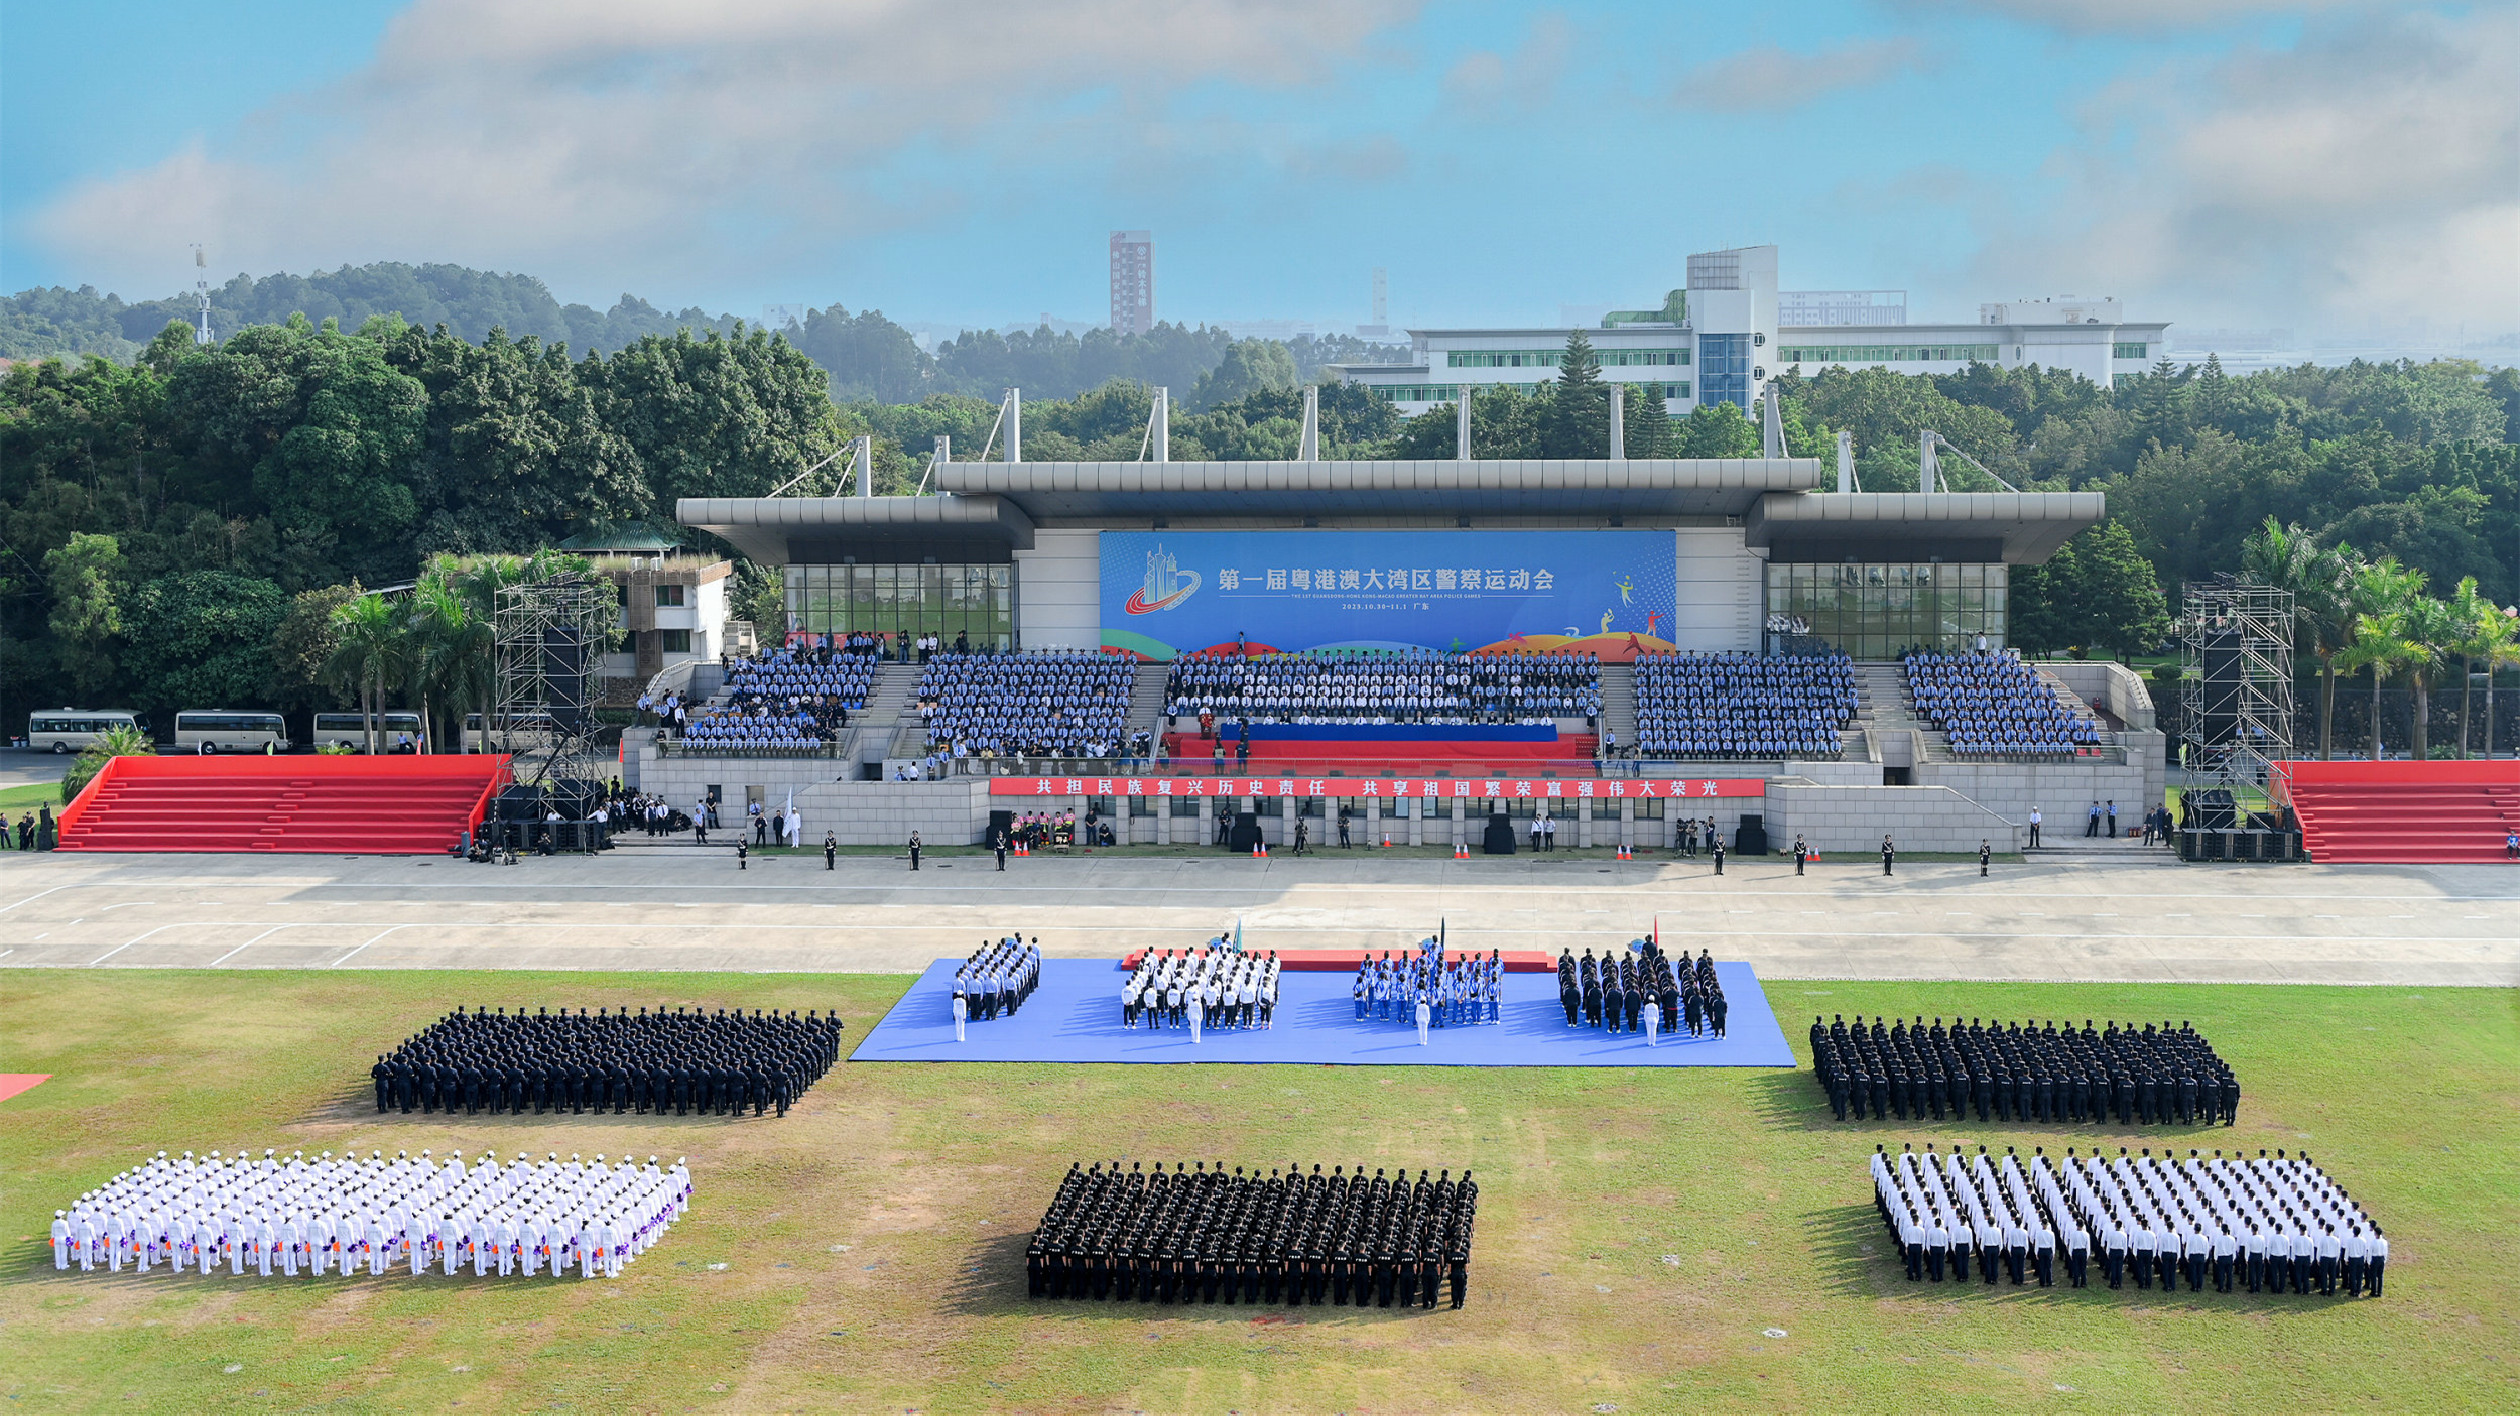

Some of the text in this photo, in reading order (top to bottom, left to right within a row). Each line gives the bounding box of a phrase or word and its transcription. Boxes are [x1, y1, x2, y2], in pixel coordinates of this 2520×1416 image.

[1218, 568, 1555, 591] 第一届粤港澳大湾区警察运动会
[1413, 602, 1430, 610] 广东
[1036, 778, 1719, 797] 共担民族复兴历史责任 共享祖国繁荣富强伟大荣光
